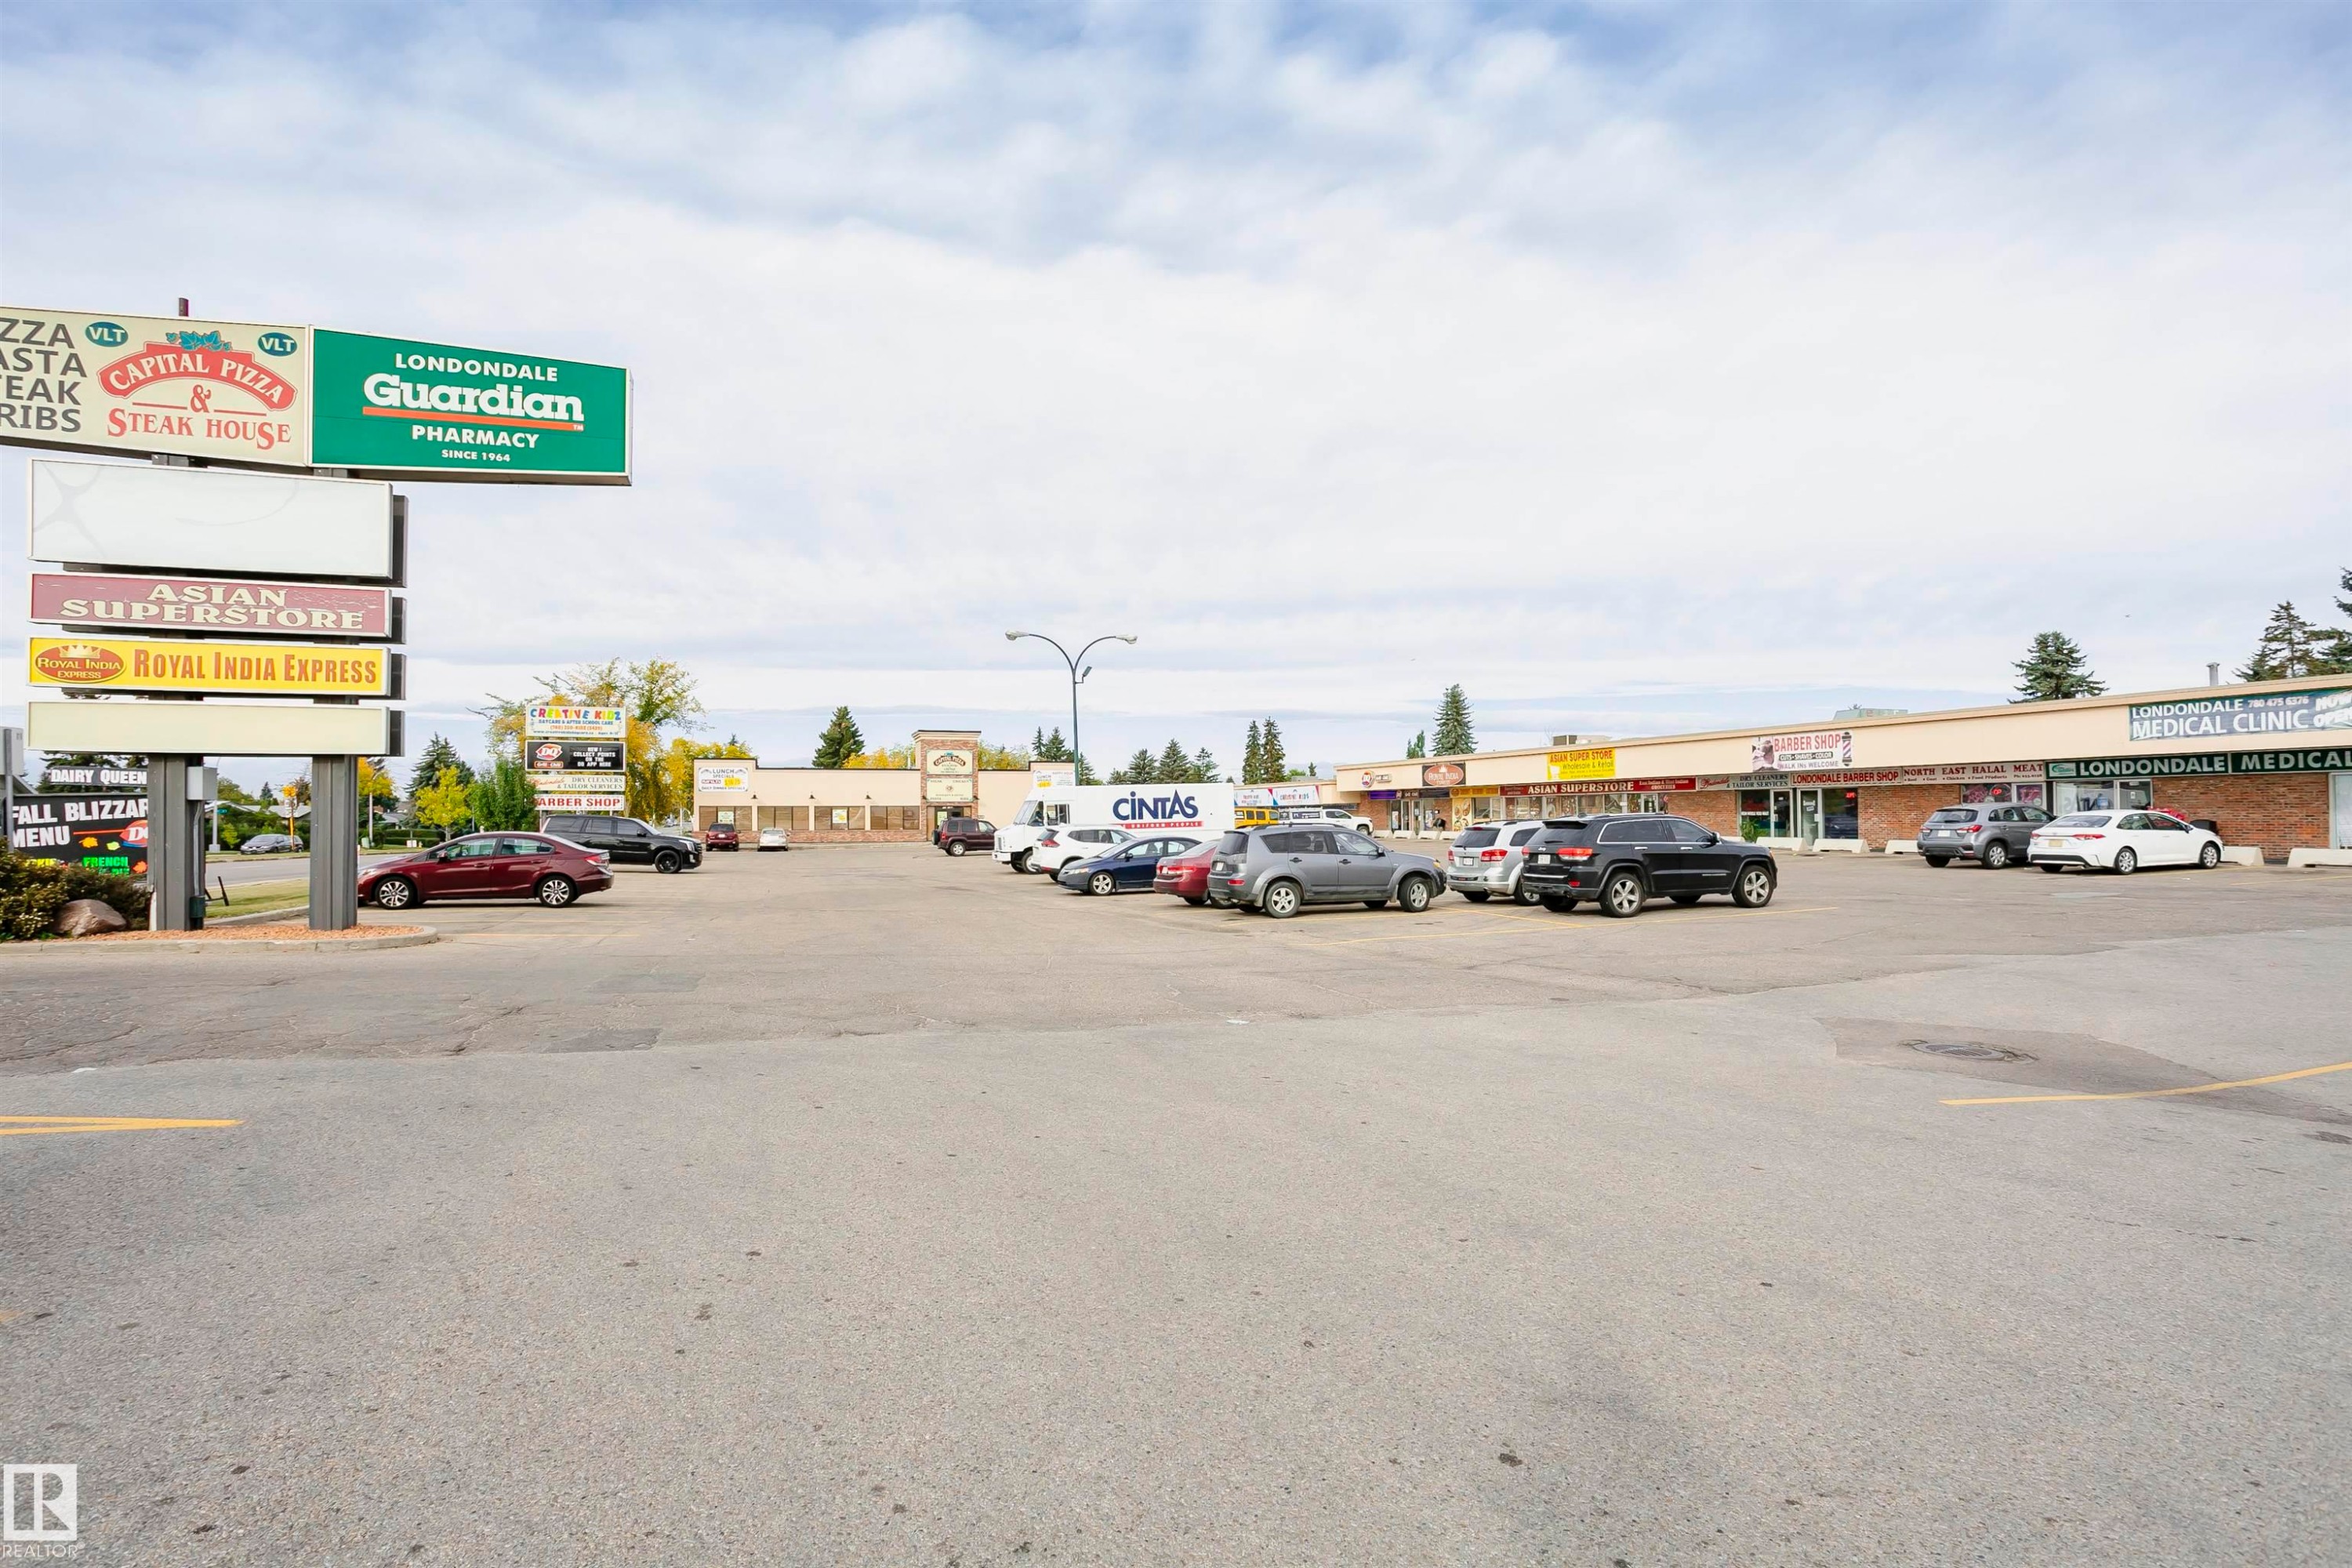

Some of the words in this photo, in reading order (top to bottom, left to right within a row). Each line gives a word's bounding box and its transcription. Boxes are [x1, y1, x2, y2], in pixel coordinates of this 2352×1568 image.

[89, 326, 125, 343] VLT
[262, 337, 294, 352] VLT
[395, 353, 558, 382] LONDONDALE
[109, 354, 209, 390] CAPITAL
[220, 358, 284, 403] PIZZA
[0, 374, 82, 405] EAK
[190, 384, 212, 413] &
[363, 372, 585, 422] Guardian
[0, 403, 82, 432] RIBS
[107, 408, 194, 437] STEAK
[205, 419, 292, 450] HOUSE
[412, 425, 539, 448] PHARMACY
[441, 449, 477, 460] SINCE
[481, 452, 510, 463] 1964
[147, 583, 288, 608] ASIAN
[60, 599, 364, 630] SUPERSTORE
[37, 657, 81, 670] ROYAL
[85, 659, 122, 671] INDIA
[134, 649, 205, 680] ROYAL
[214, 652, 276, 681] INDIA
[285, 655, 376, 684] EXPRESS
[57, 670, 101, 680] EXPRESS
[530, 708, 590, 720] CREATIVE
[2132, 699, 2244, 719] LONDONDALE
[2248, 698, 2264, 708] 780
[2266, 697, 2284, 707] 475
[2285, 695, 2309, 705] 6376
[2132, 715, 2227, 739] MEDICAL
[2233, 709, 2309, 732] CLINIC
[541, 747, 558, 757] DQ
[1773, 735, 1812, 752] BARBER
[1814, 734, 1842, 750] SHOP
[1550, 753, 1568, 763] ASIAN
[1569, 751, 1589, 762] SUPER
[1591, 750, 1613, 760] STORE
[1598, 760, 1613, 768] Retail
[2080, 756, 2226, 776] LONDONDALE
[2241, 750, 2352, 770] MEDICAL
[50, 769, 94, 783] DAIRY
[100, 769, 147, 785] QUEEN
[1793, 773, 1841, 784] LONDONDALE
[1843, 772, 1874, 782] BARBER
[1876, 771, 1898, 781] SHOP
[1904, 768, 1935, 776] NORTH
[1973, 765, 2006, 774] HALAL
[2013, 764, 2043, 772] MEAT
[1528, 785, 1557, 794] ASIAN
[1561, 781, 1634, 793] SUPERSTORE
[537, 798, 582, 807] ARBER
[586, 798, 620, 807] SHOP
[13, 826, 71, 848] MENU
[82, 856, 129, 867] FRENCH
